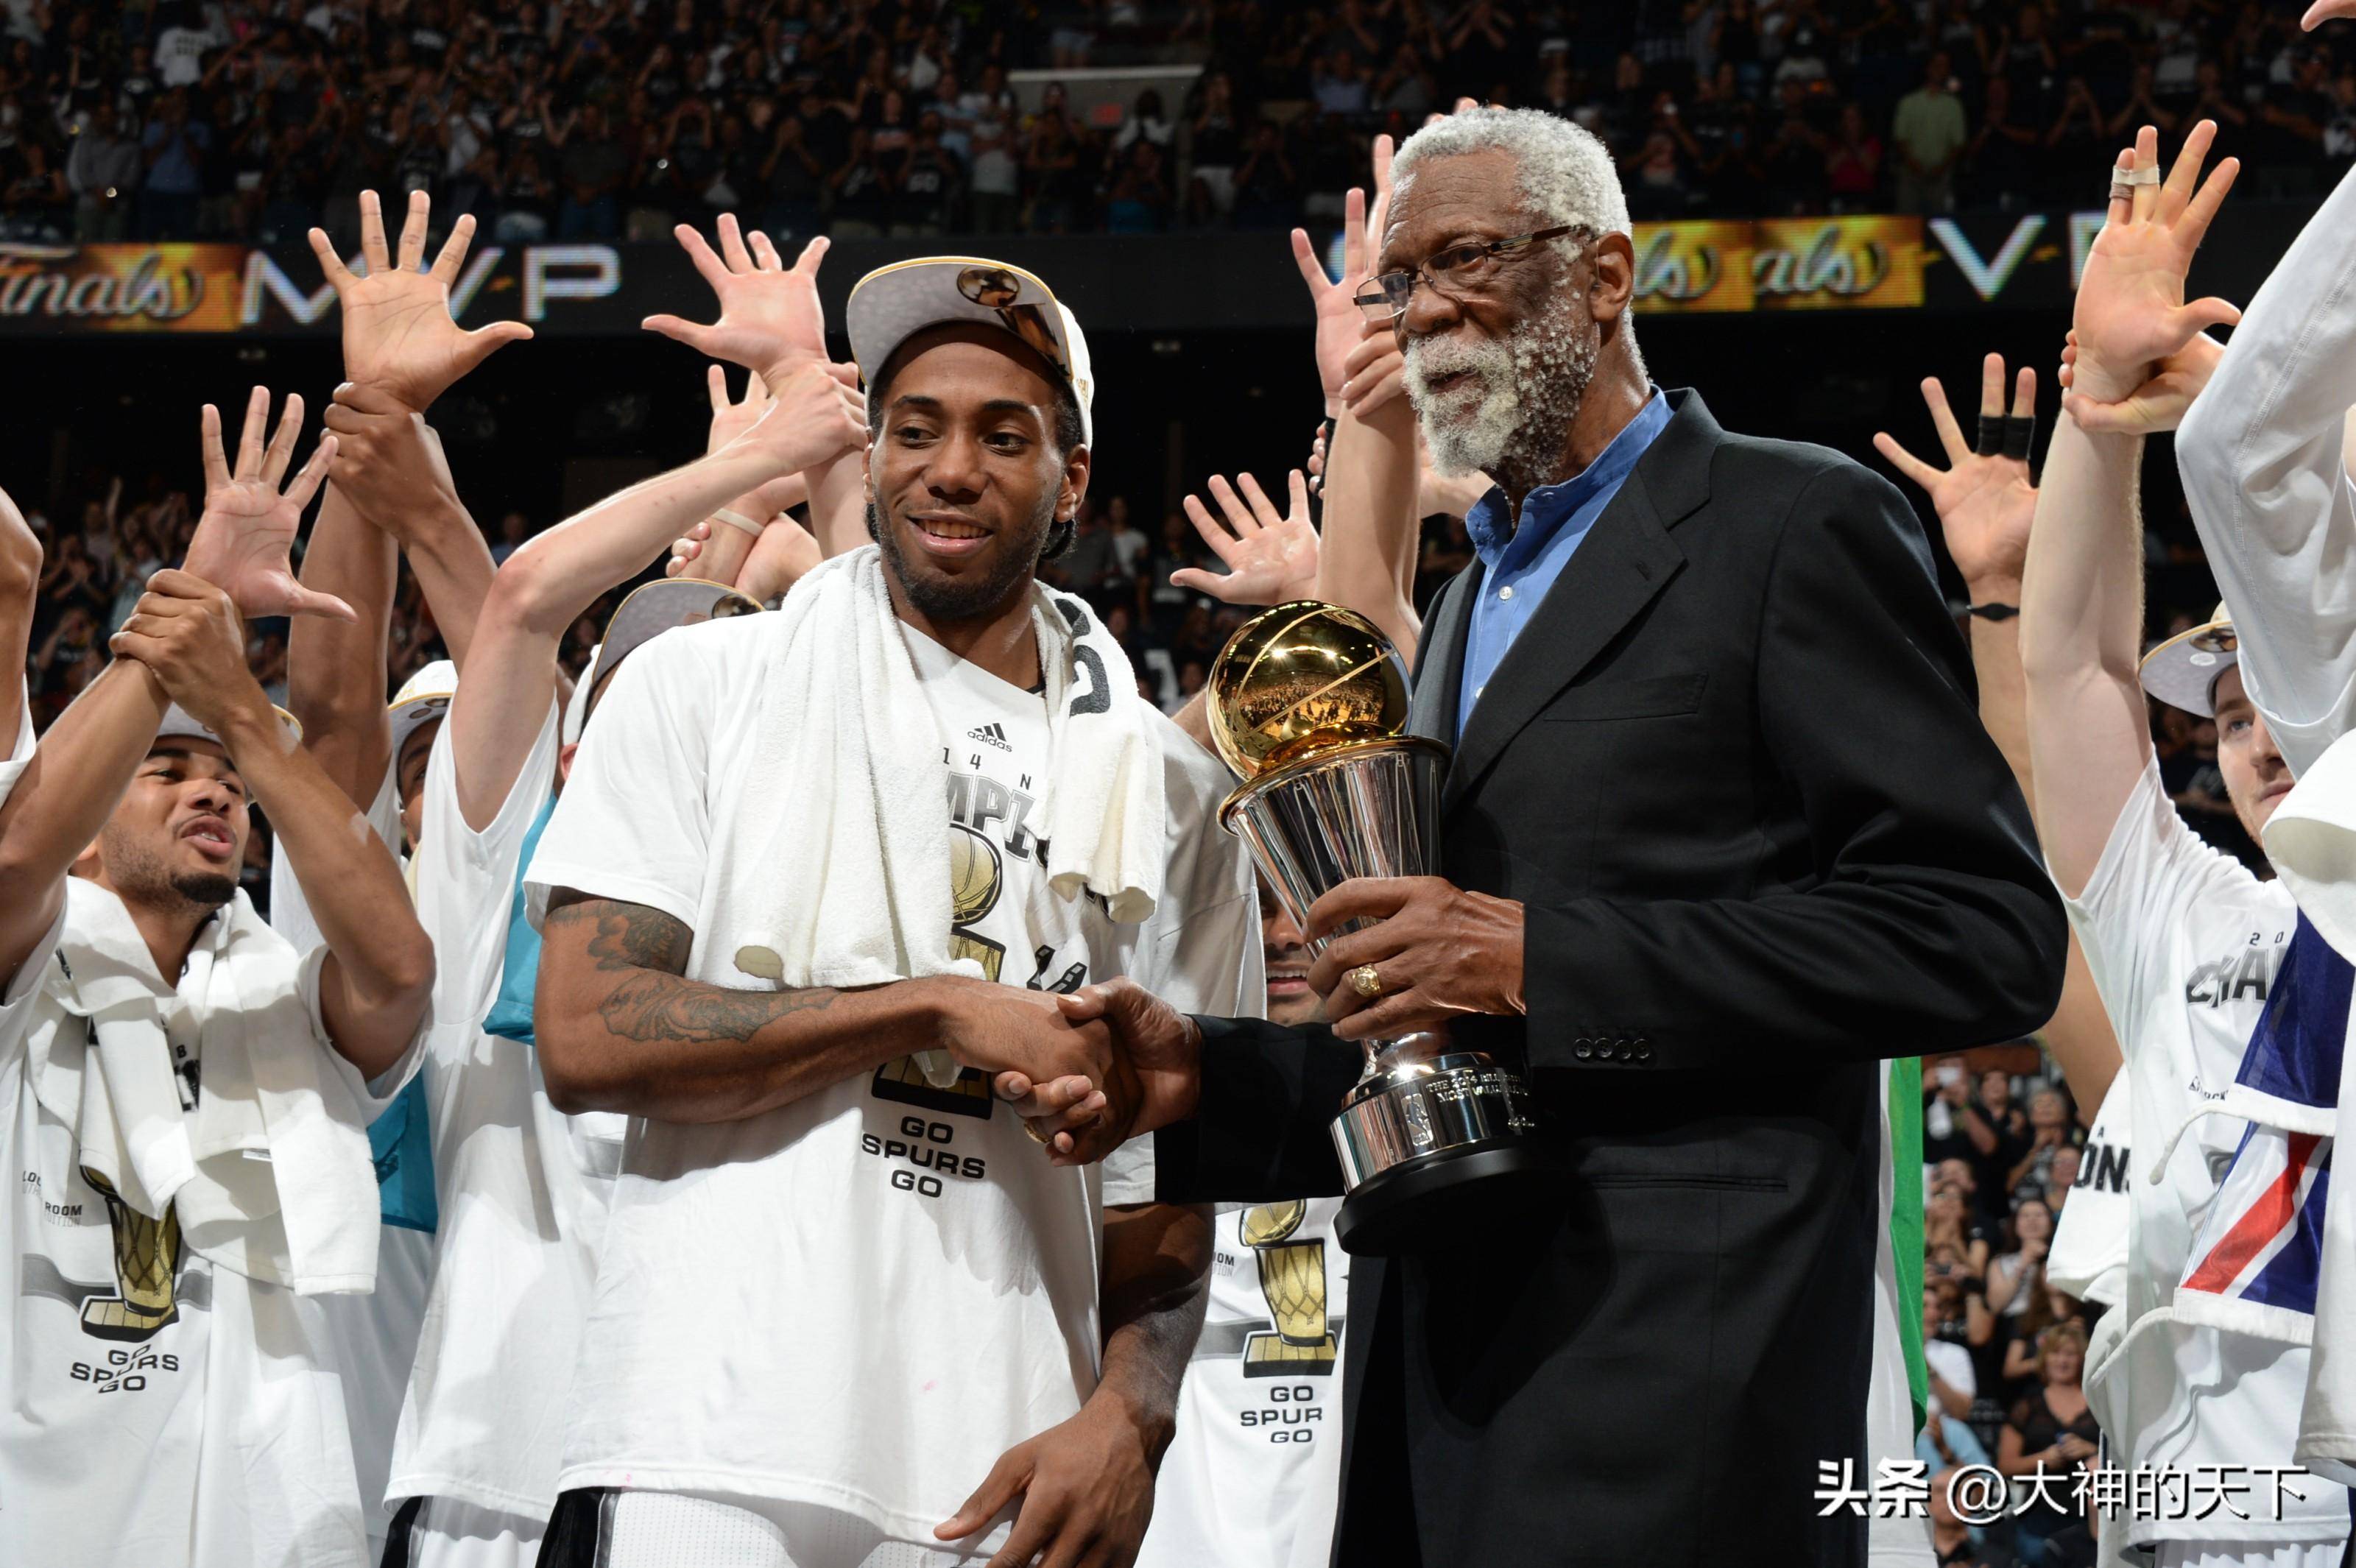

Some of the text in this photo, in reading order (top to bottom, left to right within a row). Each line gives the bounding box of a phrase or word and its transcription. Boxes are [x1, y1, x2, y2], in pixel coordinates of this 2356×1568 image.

[967, 730, 1013, 752] adidas
[1426, 1079, 1449, 1092] THE
[900, 1115, 953, 1145] GO
[861, 1132, 986, 1179] SPURS
[2073, 1143, 2131, 1194] ON
[891, 1169, 943, 1198] GO
[45, 1201, 83, 1216] ROOM
[108, 1344, 152, 1366] GO
[70, 1354, 179, 1384] SPURS
[98, 1375, 147, 1394] GO
[1270, 1385, 1313, 1402] GO
[1270, 1429, 1313, 1444] GO
